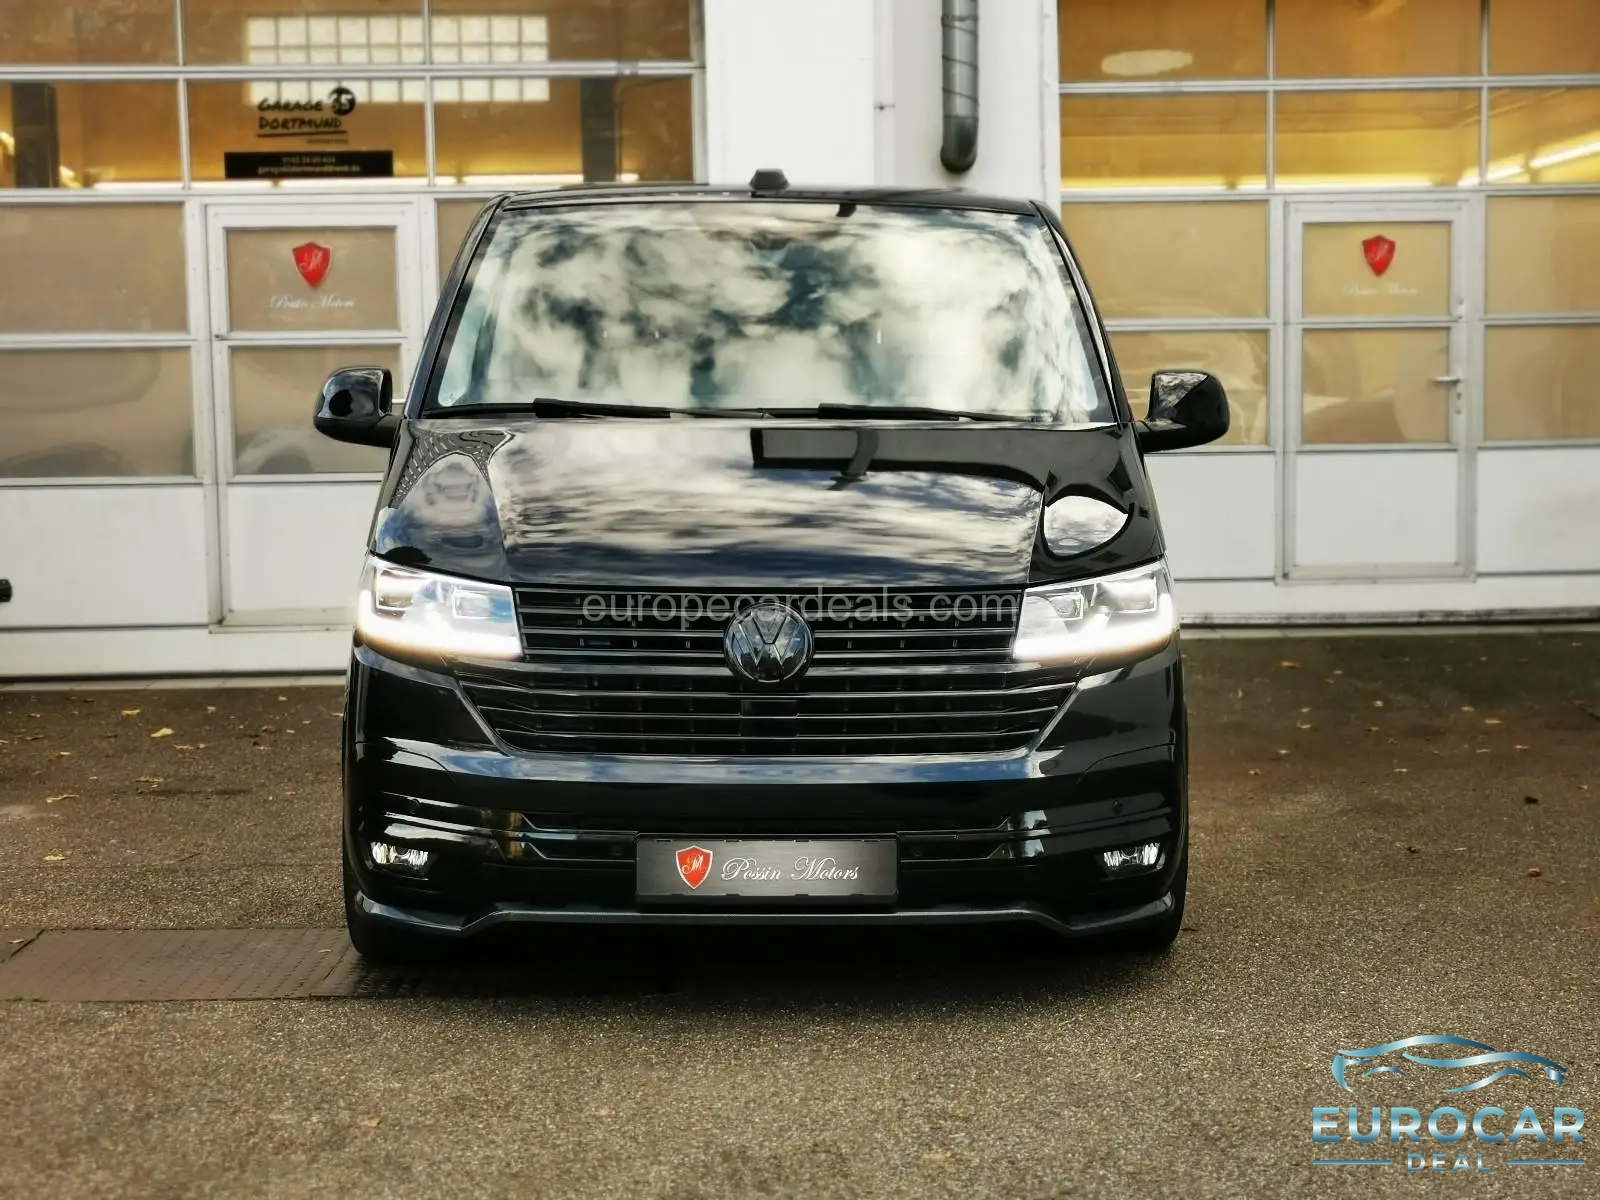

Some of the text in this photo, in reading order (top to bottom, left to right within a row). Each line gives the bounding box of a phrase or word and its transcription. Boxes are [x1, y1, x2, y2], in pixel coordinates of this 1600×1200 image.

[257, 97, 323, 112] GARAGE
[258, 116, 342, 130] DORTMUND
[721, 857, 782, 881] Possin
[790, 856, 860, 881] Motors
